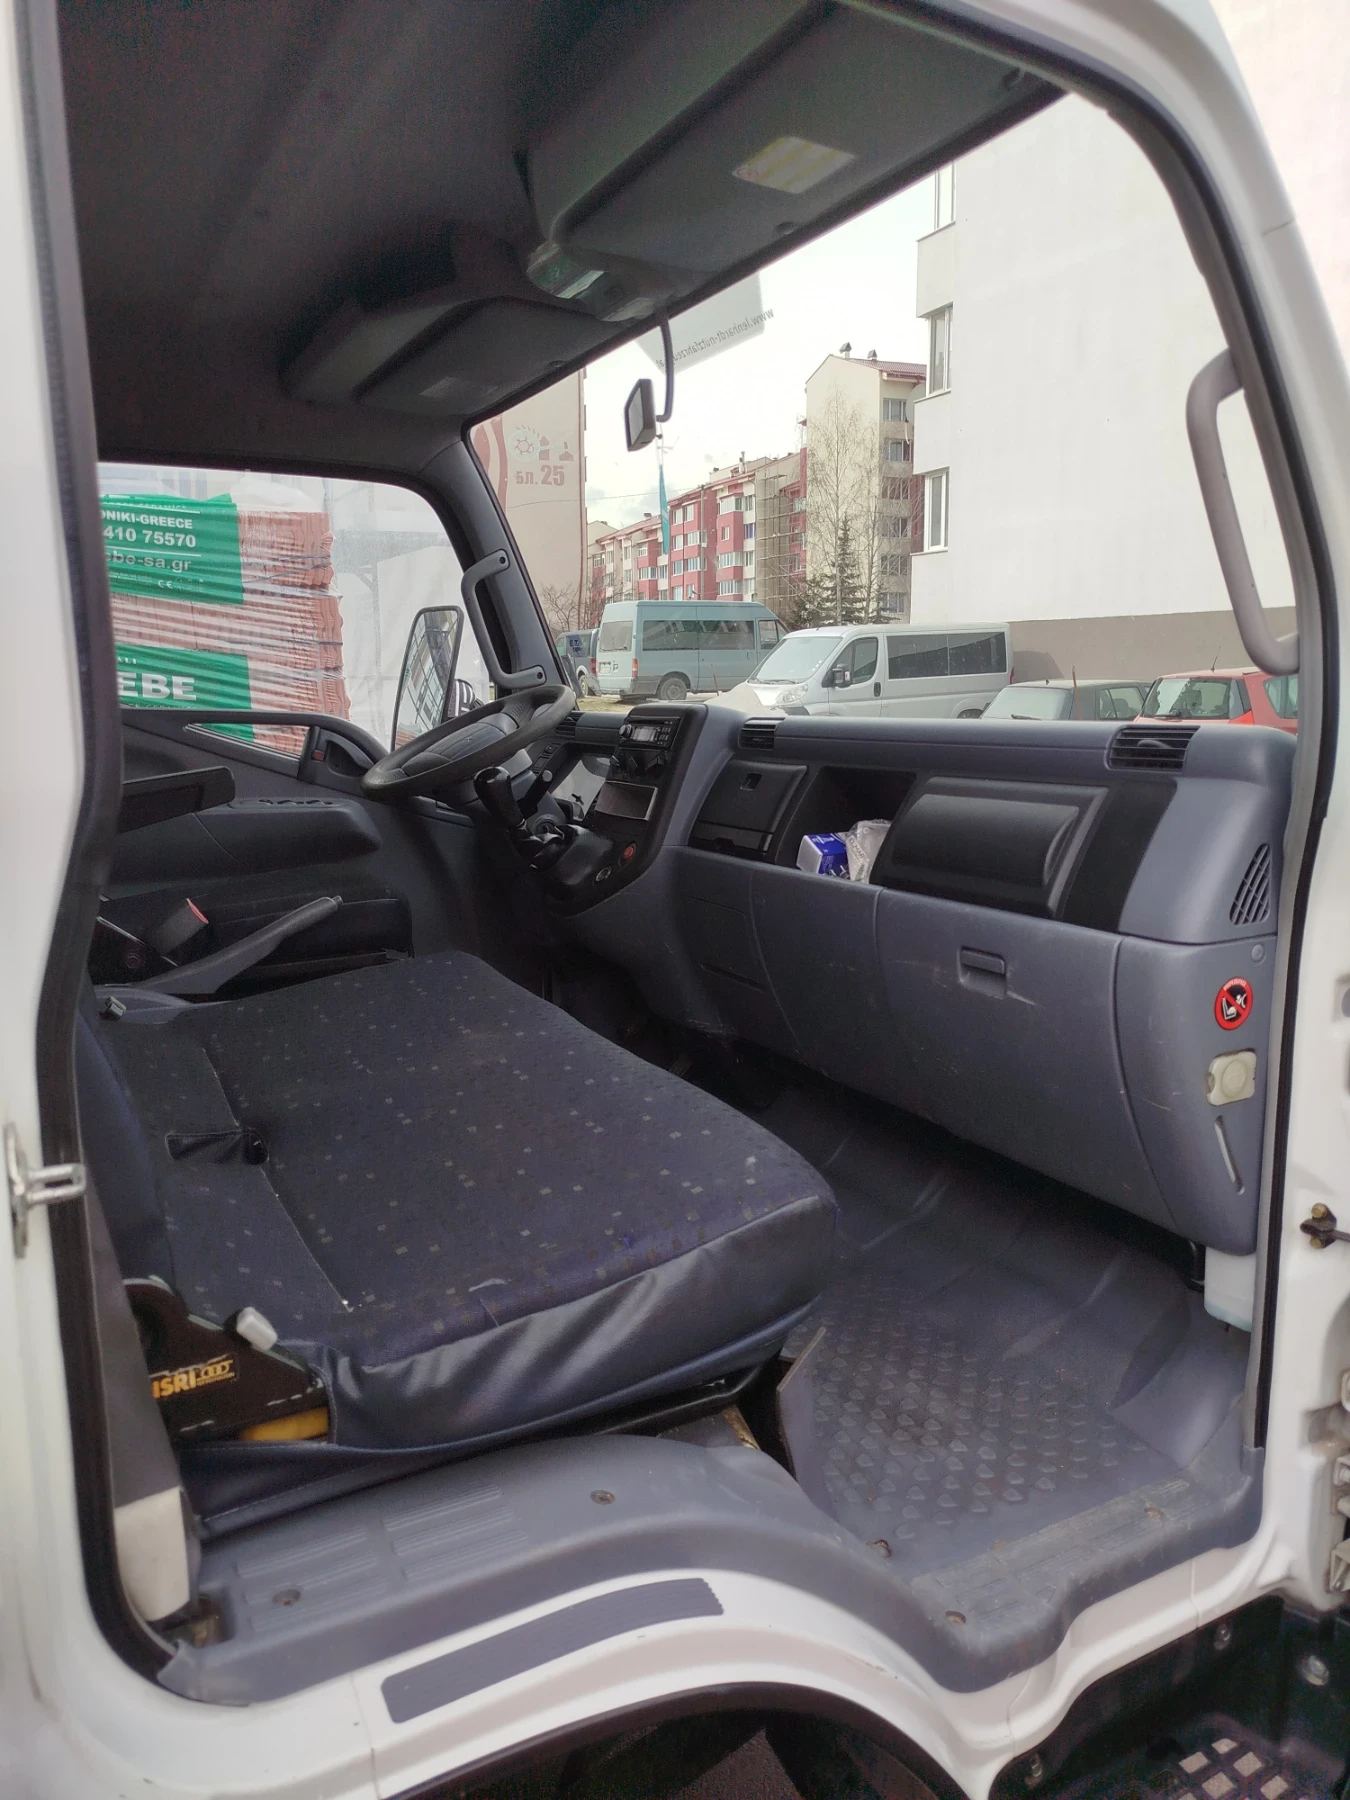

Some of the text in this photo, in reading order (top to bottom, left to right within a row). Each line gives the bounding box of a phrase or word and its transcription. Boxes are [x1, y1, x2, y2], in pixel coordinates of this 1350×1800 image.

[540, 464, 565, 486] 25
[142, 529, 196, 548] 75570
[116, 671, 197, 701] EBE
[152, 1370, 196, 1398] ISRI
